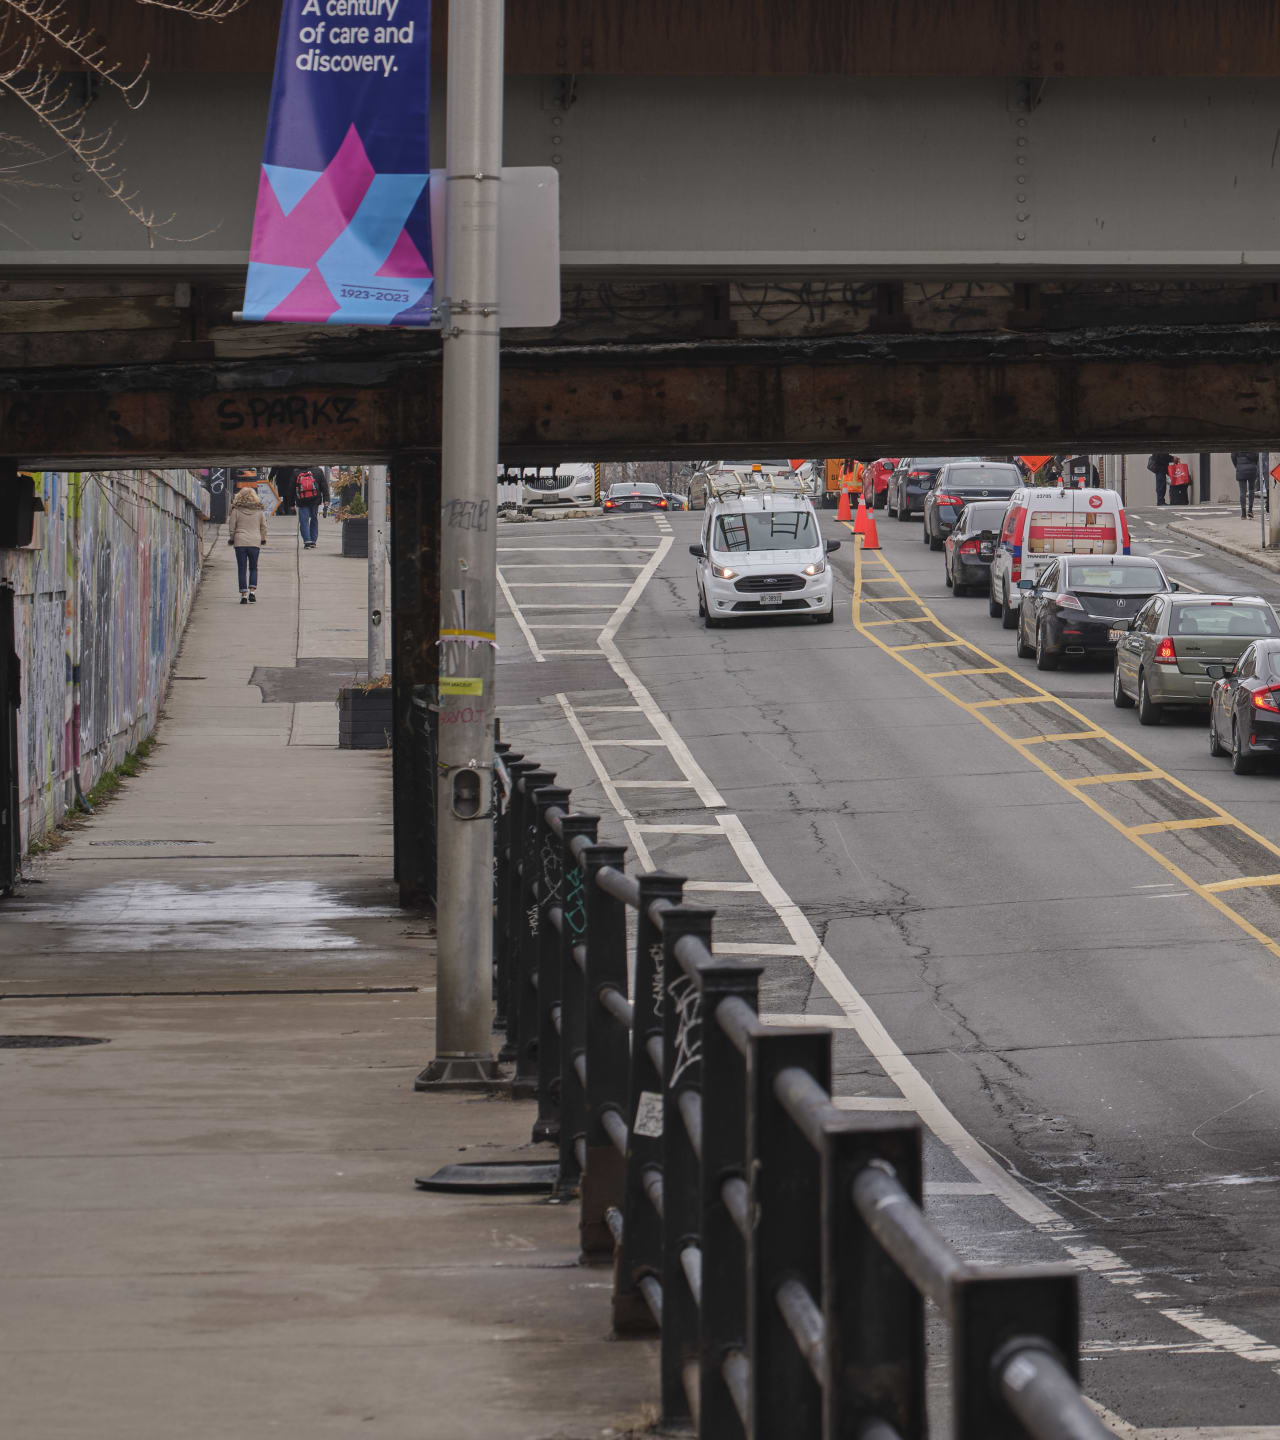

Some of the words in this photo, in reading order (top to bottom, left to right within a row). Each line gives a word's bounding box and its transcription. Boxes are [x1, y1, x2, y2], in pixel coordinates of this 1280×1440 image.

[299, 21, 326, 44] of
[329, 26, 370, 44] care
[373, 21, 414, 44] and
[296, 49, 398, 77] discovery.
[340, 288, 409, 303] 1923-2023
